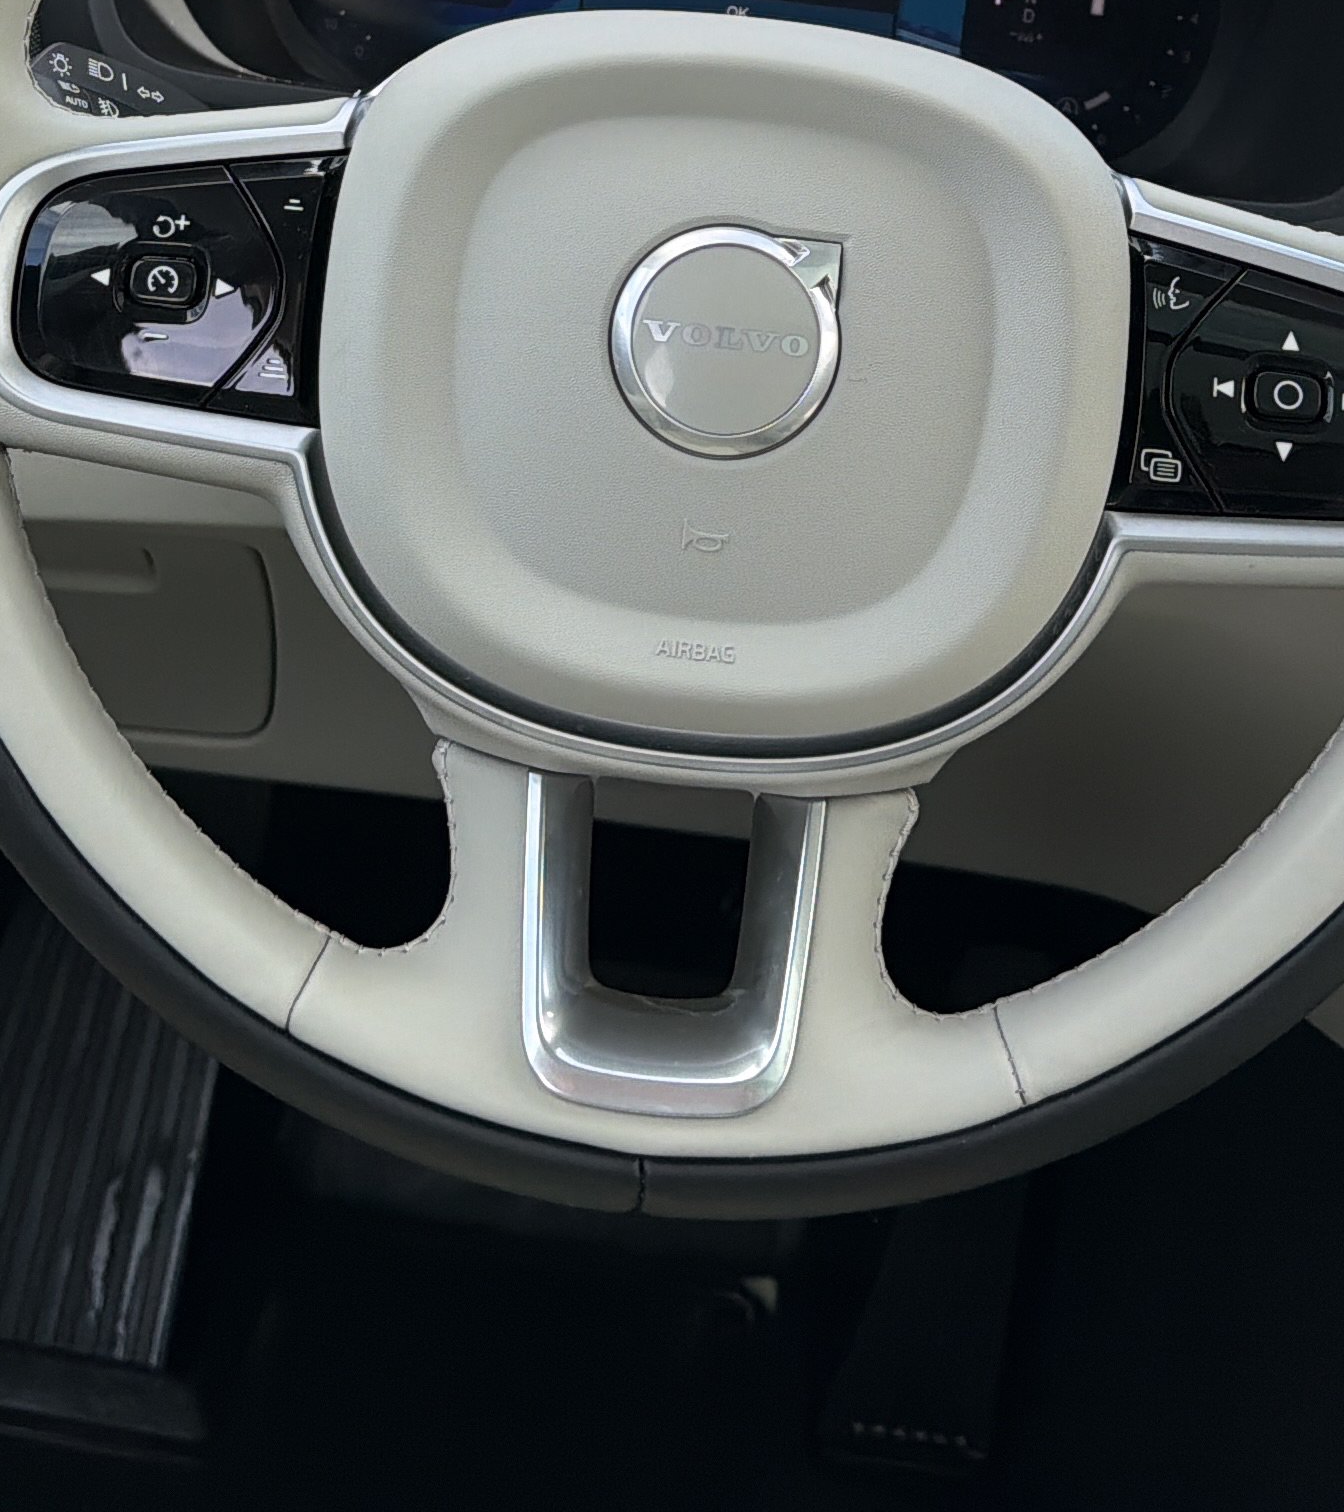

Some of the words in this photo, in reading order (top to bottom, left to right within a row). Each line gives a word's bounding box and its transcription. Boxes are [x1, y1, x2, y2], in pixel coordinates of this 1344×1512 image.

[1022, 8, 1036, 24] D
[65, 94, 89, 109] AUTO
[642, 319, 810, 357] VOLVO
[655, 638, 736, 665] AIRBAG
